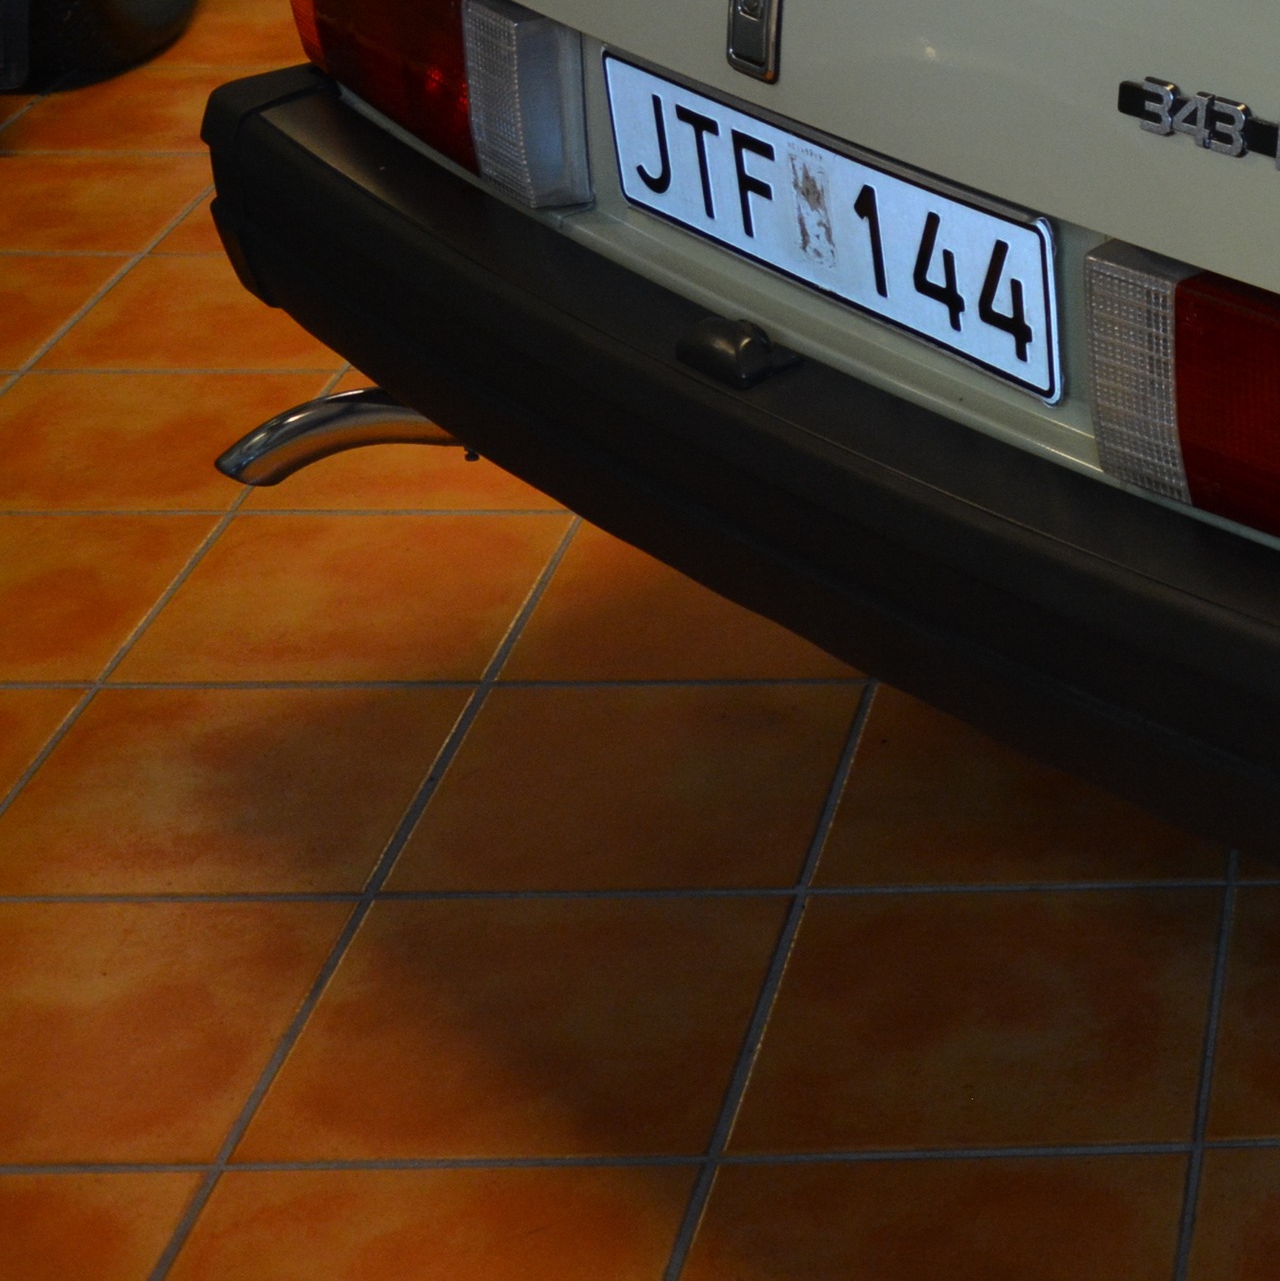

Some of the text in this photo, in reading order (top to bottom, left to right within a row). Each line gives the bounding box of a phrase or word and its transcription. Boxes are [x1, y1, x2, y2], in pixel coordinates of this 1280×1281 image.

[1140, 76, 1250, 158] 343
[636, 94, 1033, 362] JTF 144
